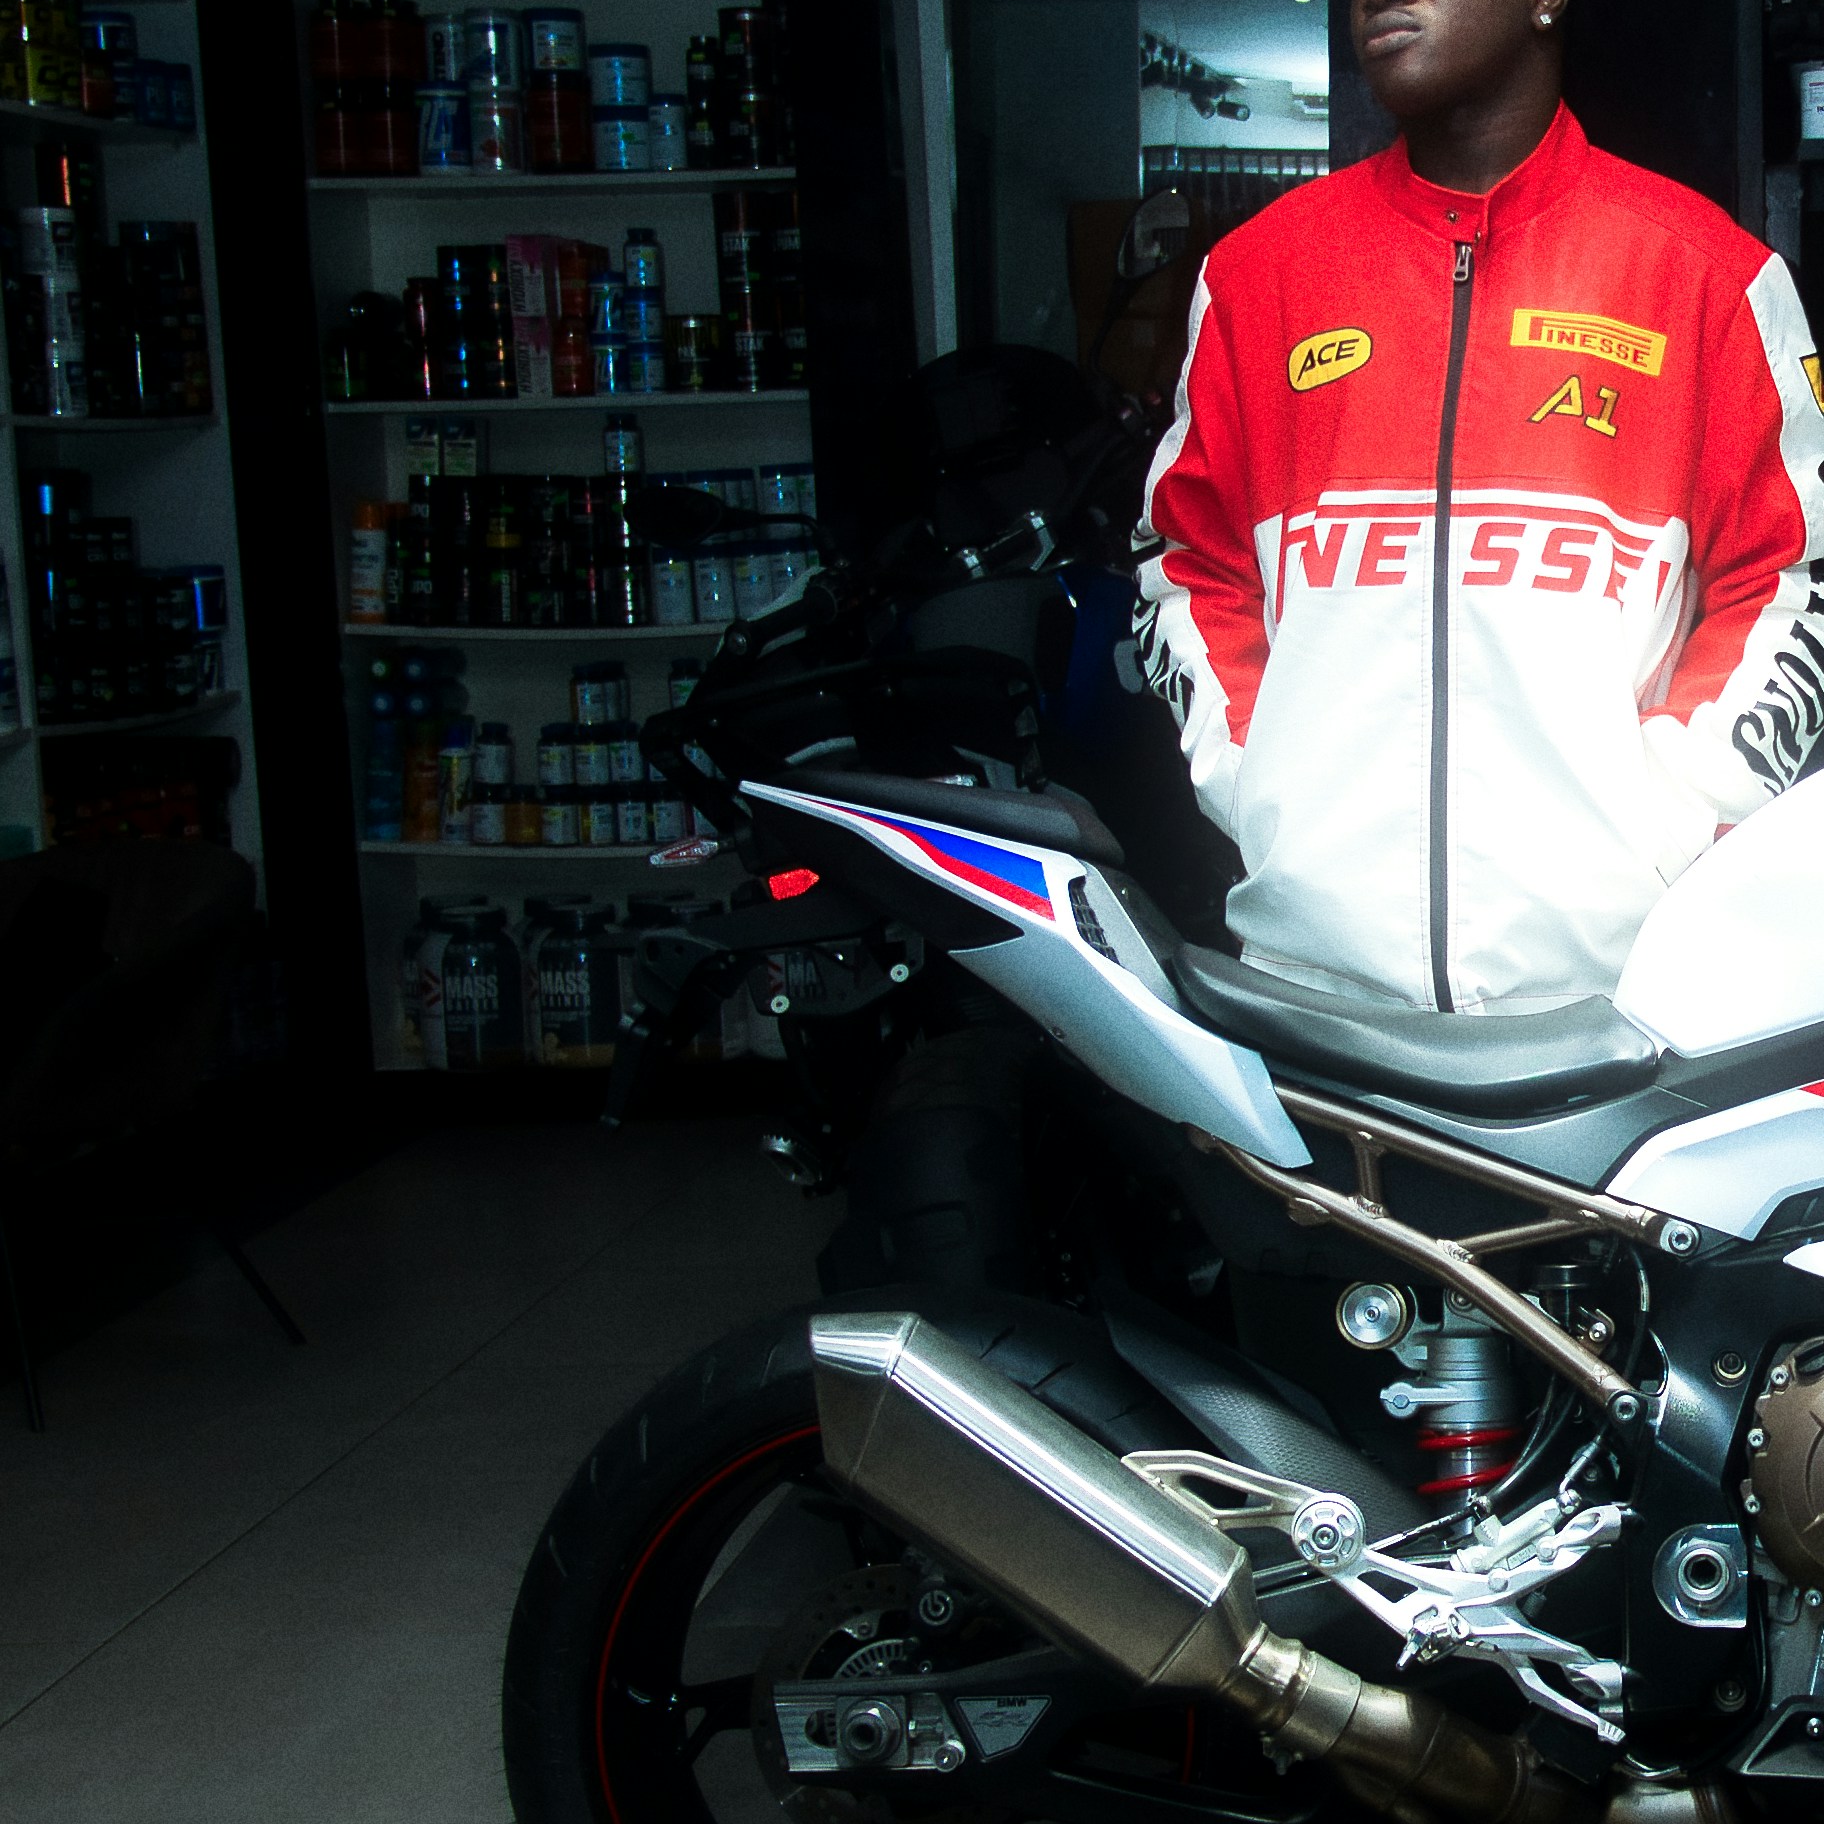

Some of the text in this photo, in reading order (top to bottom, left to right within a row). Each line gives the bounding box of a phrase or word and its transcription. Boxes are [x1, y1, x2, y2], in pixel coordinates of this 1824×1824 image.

[1296, 337, 1361, 383] ACE
[1526, 374, 1621, 439] A1
[444, 974, 499, 1000] MASS
[539, 969, 591, 996] MASS
[996, 1696, 1027, 1708] BMW
